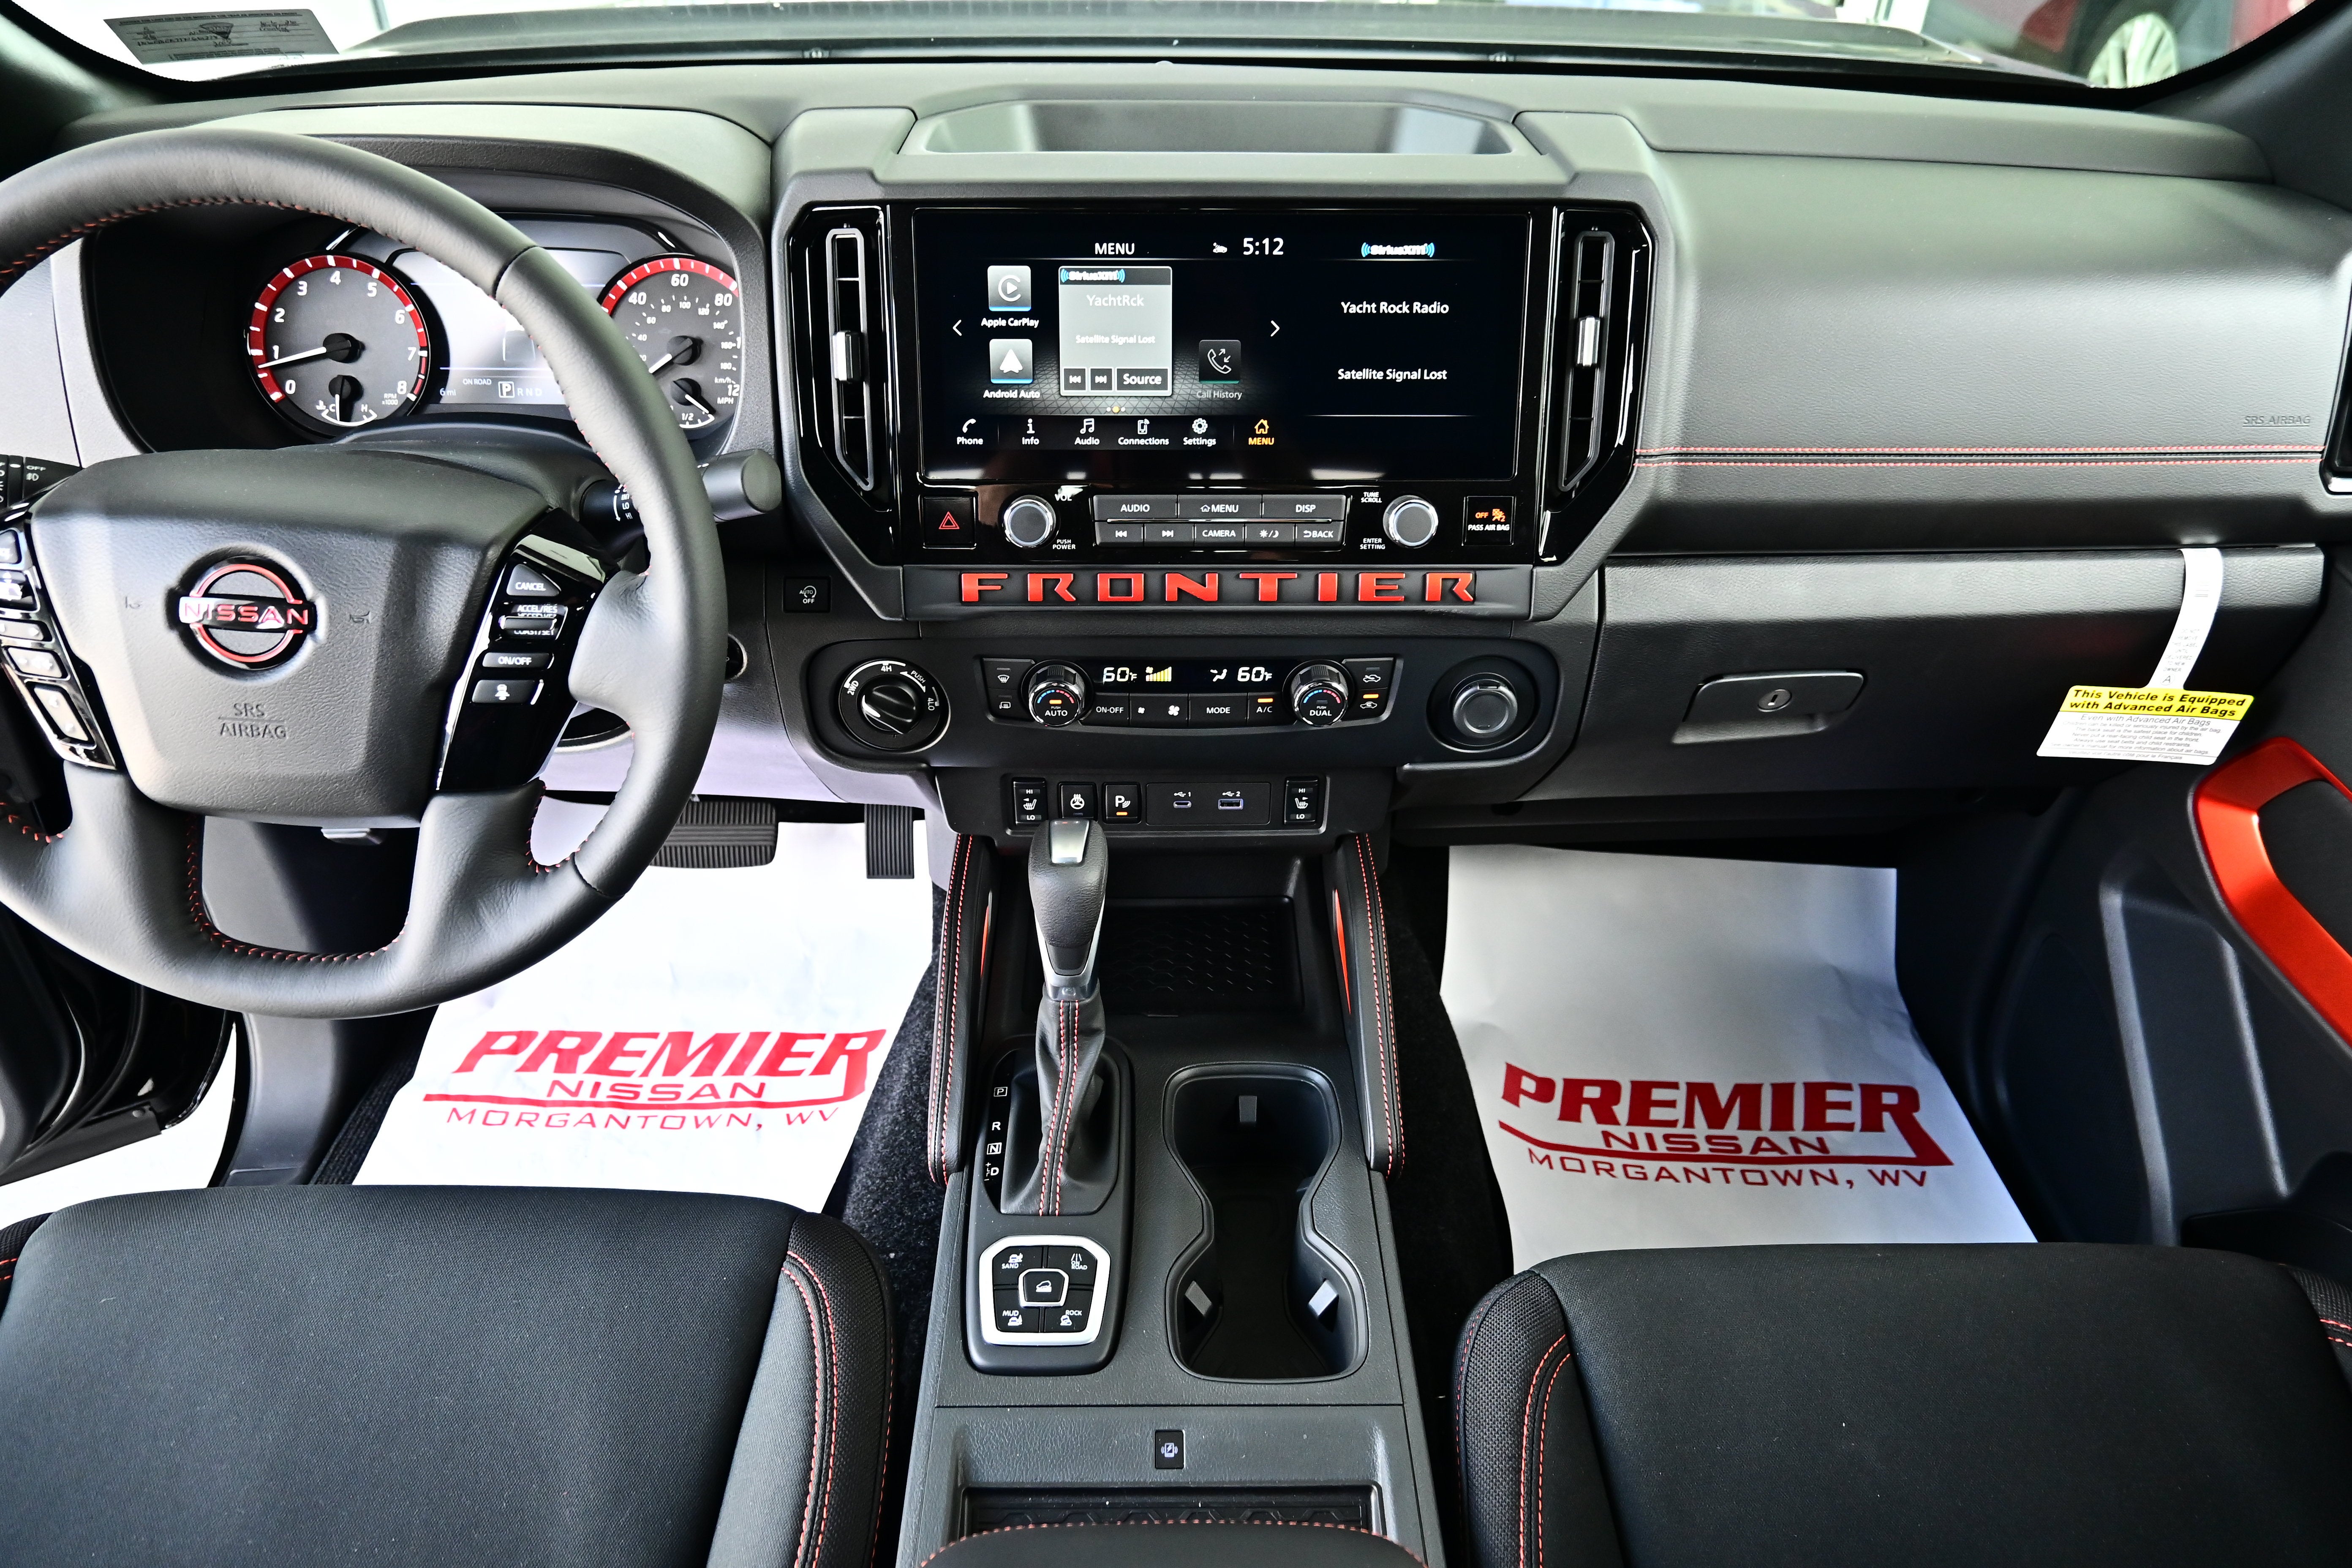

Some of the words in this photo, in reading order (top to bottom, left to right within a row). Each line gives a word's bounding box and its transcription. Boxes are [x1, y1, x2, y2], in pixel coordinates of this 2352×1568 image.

[1094, 243, 1135, 255] MENU
[1243, 237, 1284, 255] 5:12
[330, 271, 341, 285] 4
[671, 274, 689, 286] 60
[297, 281, 308, 296] 3
[368, 282, 377, 297] 5
[628, 292, 647, 305] 40
[715, 294, 732, 306] 80
[1086, 294, 1144, 307] YachtRck
[1341, 301, 1377, 314] Yacht
[1380, 301, 1410, 314] Rock
[1413, 301, 1450, 314] Radio
[274, 308, 285, 323] 2
[395, 310, 405, 324] 6
[981, 318, 1007, 328] Apple
[1008, 318, 1039, 328] CarPlay
[1075, 335, 1110, 344] Satellite
[1111, 335, 1137, 346] Signal
[1138, 335, 1156, 344] Lost
[272, 345, 279, 359] 1
[408, 347, 416, 360] 7
[1123, 373, 1162, 385] Source
[1338, 368, 1384, 380] Satellite
[1386, 368, 1421, 382] Signal
[1424, 369, 1448, 380] Lost
[285, 379, 296, 394] 0
[397, 381, 407, 395] 8
[440, 388, 446, 396] 6
[727, 384, 740, 396] 12
[983, 389, 1018, 399] Android
[1019, 390, 1041, 399] Auto
[1213, 391, 1242, 400] History
[329, 404, 335, 412] C
[2243, 416, 2265, 424] SRS
[2268, 416, 2311, 425] AIRBAG
[957, 436, 983, 446] Phone
[1022, 436, 1040, 446] Info
[1074, 436, 1100, 446] Audio
[1118, 437, 1169, 446] Connections
[1183, 437, 1217, 446] Settings
[1055, 493, 1072, 501] VOL
[1120, 504, 1150, 512] AUDIO
[1211, 504, 1239, 513] MENU
[1295, 504, 1316, 513] DISP
[1312, 530, 1334, 538] BACK
[515, 581, 546, 591] CANCEL
[961, 572, 1474, 602] FRONTIER
[185, 602, 308, 625] NISSAN
[517, 604, 558, 614] ACCEL/RES
[498, 656, 532, 665] ON/OFF
[911, 670, 926, 683] PUSH
[2162, 675, 2171, 683] A
[847, 680, 859, 696] 2WD
[2074, 689, 2102, 699] This
[2108, 691, 2158, 701] Vehicle
[2162, 693, 2174, 701] is
[2179, 694, 2246, 706] Equipped
[233, 702, 265, 716] SRS
[2070, 701, 2099, 709] with
[2103, 702, 2173, 712] Advanced
[2175, 705, 2197, 713] Air
[2200, 706, 2236, 717] Bags
[2125, 716, 2173, 724] Advanced
[2187, 718, 2211, 726] Bags
[220, 722, 287, 739] AIRBAG
[452, 1029, 886, 1098] PREMIER
[547, 1080, 766, 1101] NISSAN
[1501, 1062, 1941, 1147] PREMIER
[446, 1107, 763, 1132] MORGANTOWN,
[786, 1107, 840, 1126] WV
[992, 1122, 1001, 1130] R
[1601, 1130, 1830, 1155] NISSAN
[990, 1167, 999, 1176] D
[1527, 1148, 1854, 1190] MORGANTOWN,
[1868, 1169, 1927, 1187] WV
